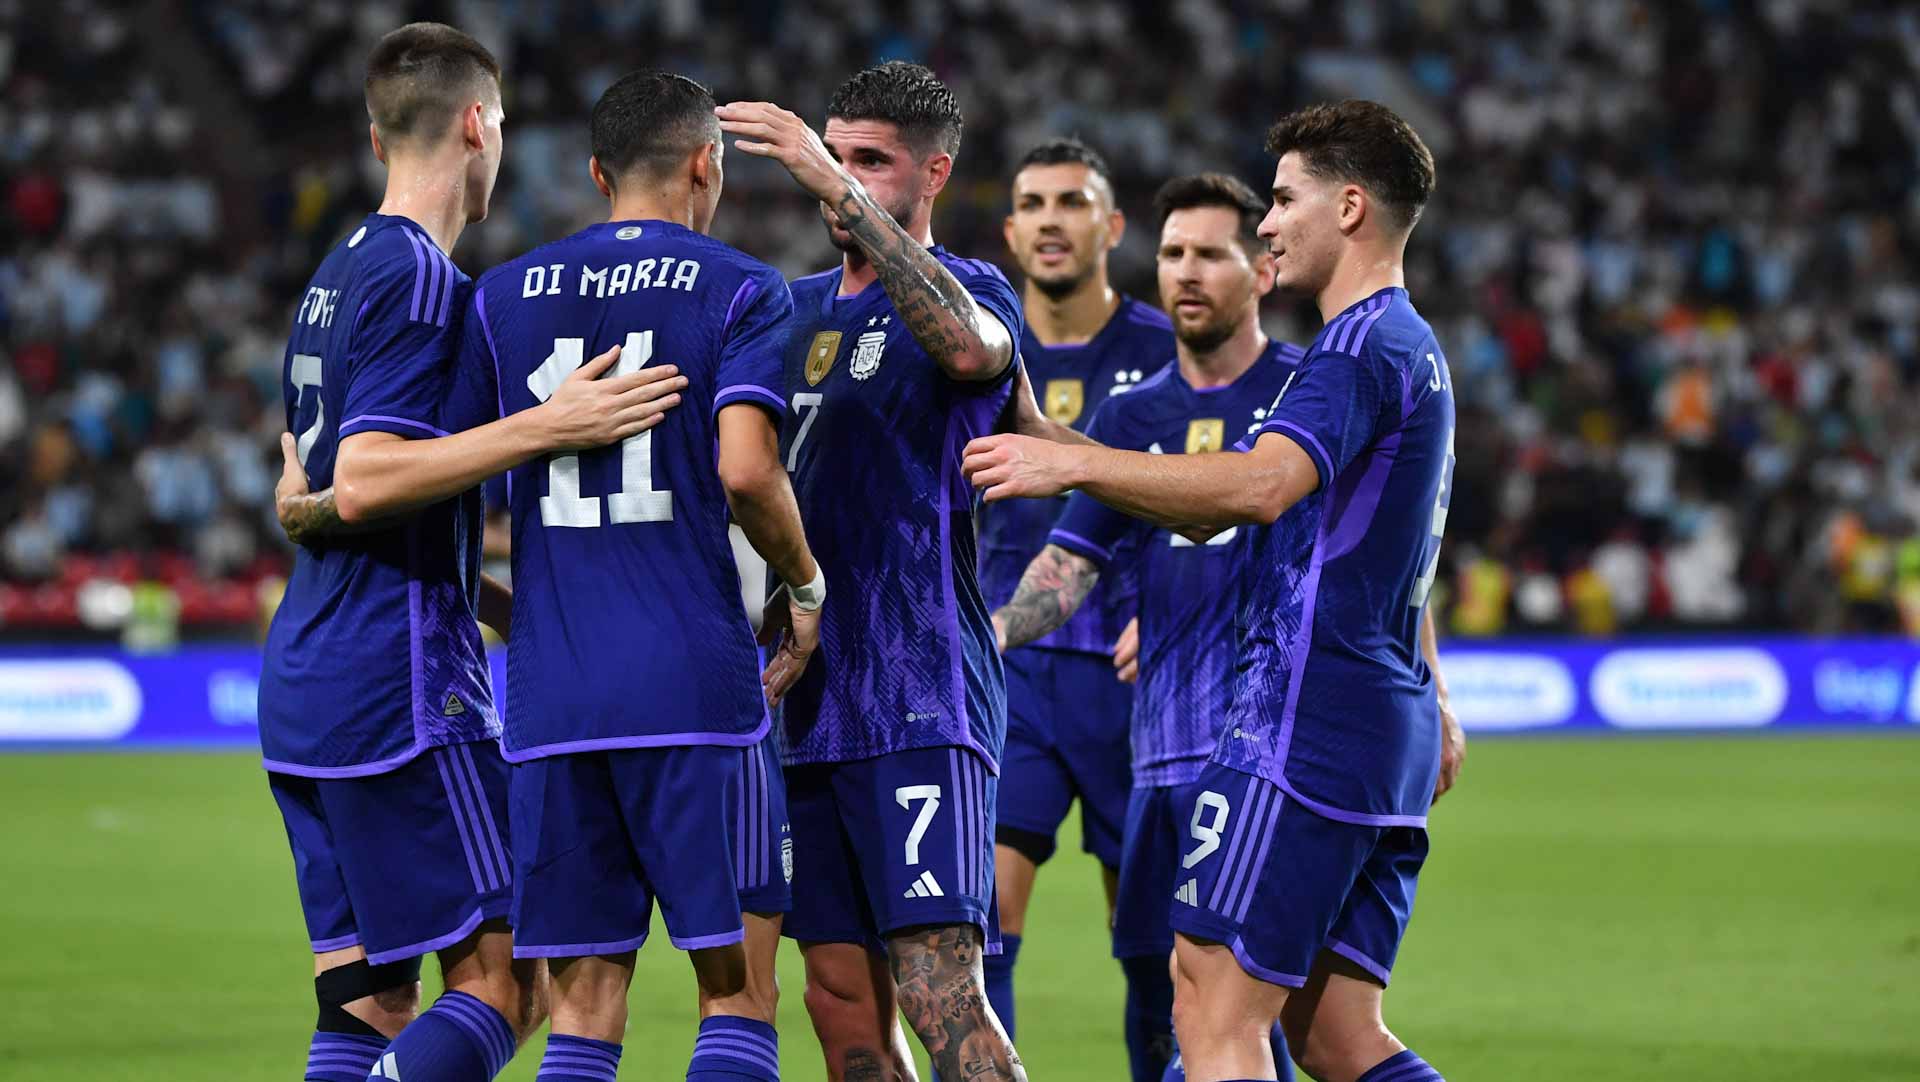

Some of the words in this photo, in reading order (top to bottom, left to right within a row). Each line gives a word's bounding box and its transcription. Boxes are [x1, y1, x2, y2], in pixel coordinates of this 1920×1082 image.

[522, 263, 565, 298] DI
[579, 256, 701, 299] MARIA
[527, 330, 674, 528] 11
[787, 392, 824, 473] 7
[895, 784, 941, 866] 7
[1181, 790, 1231, 870] 9
